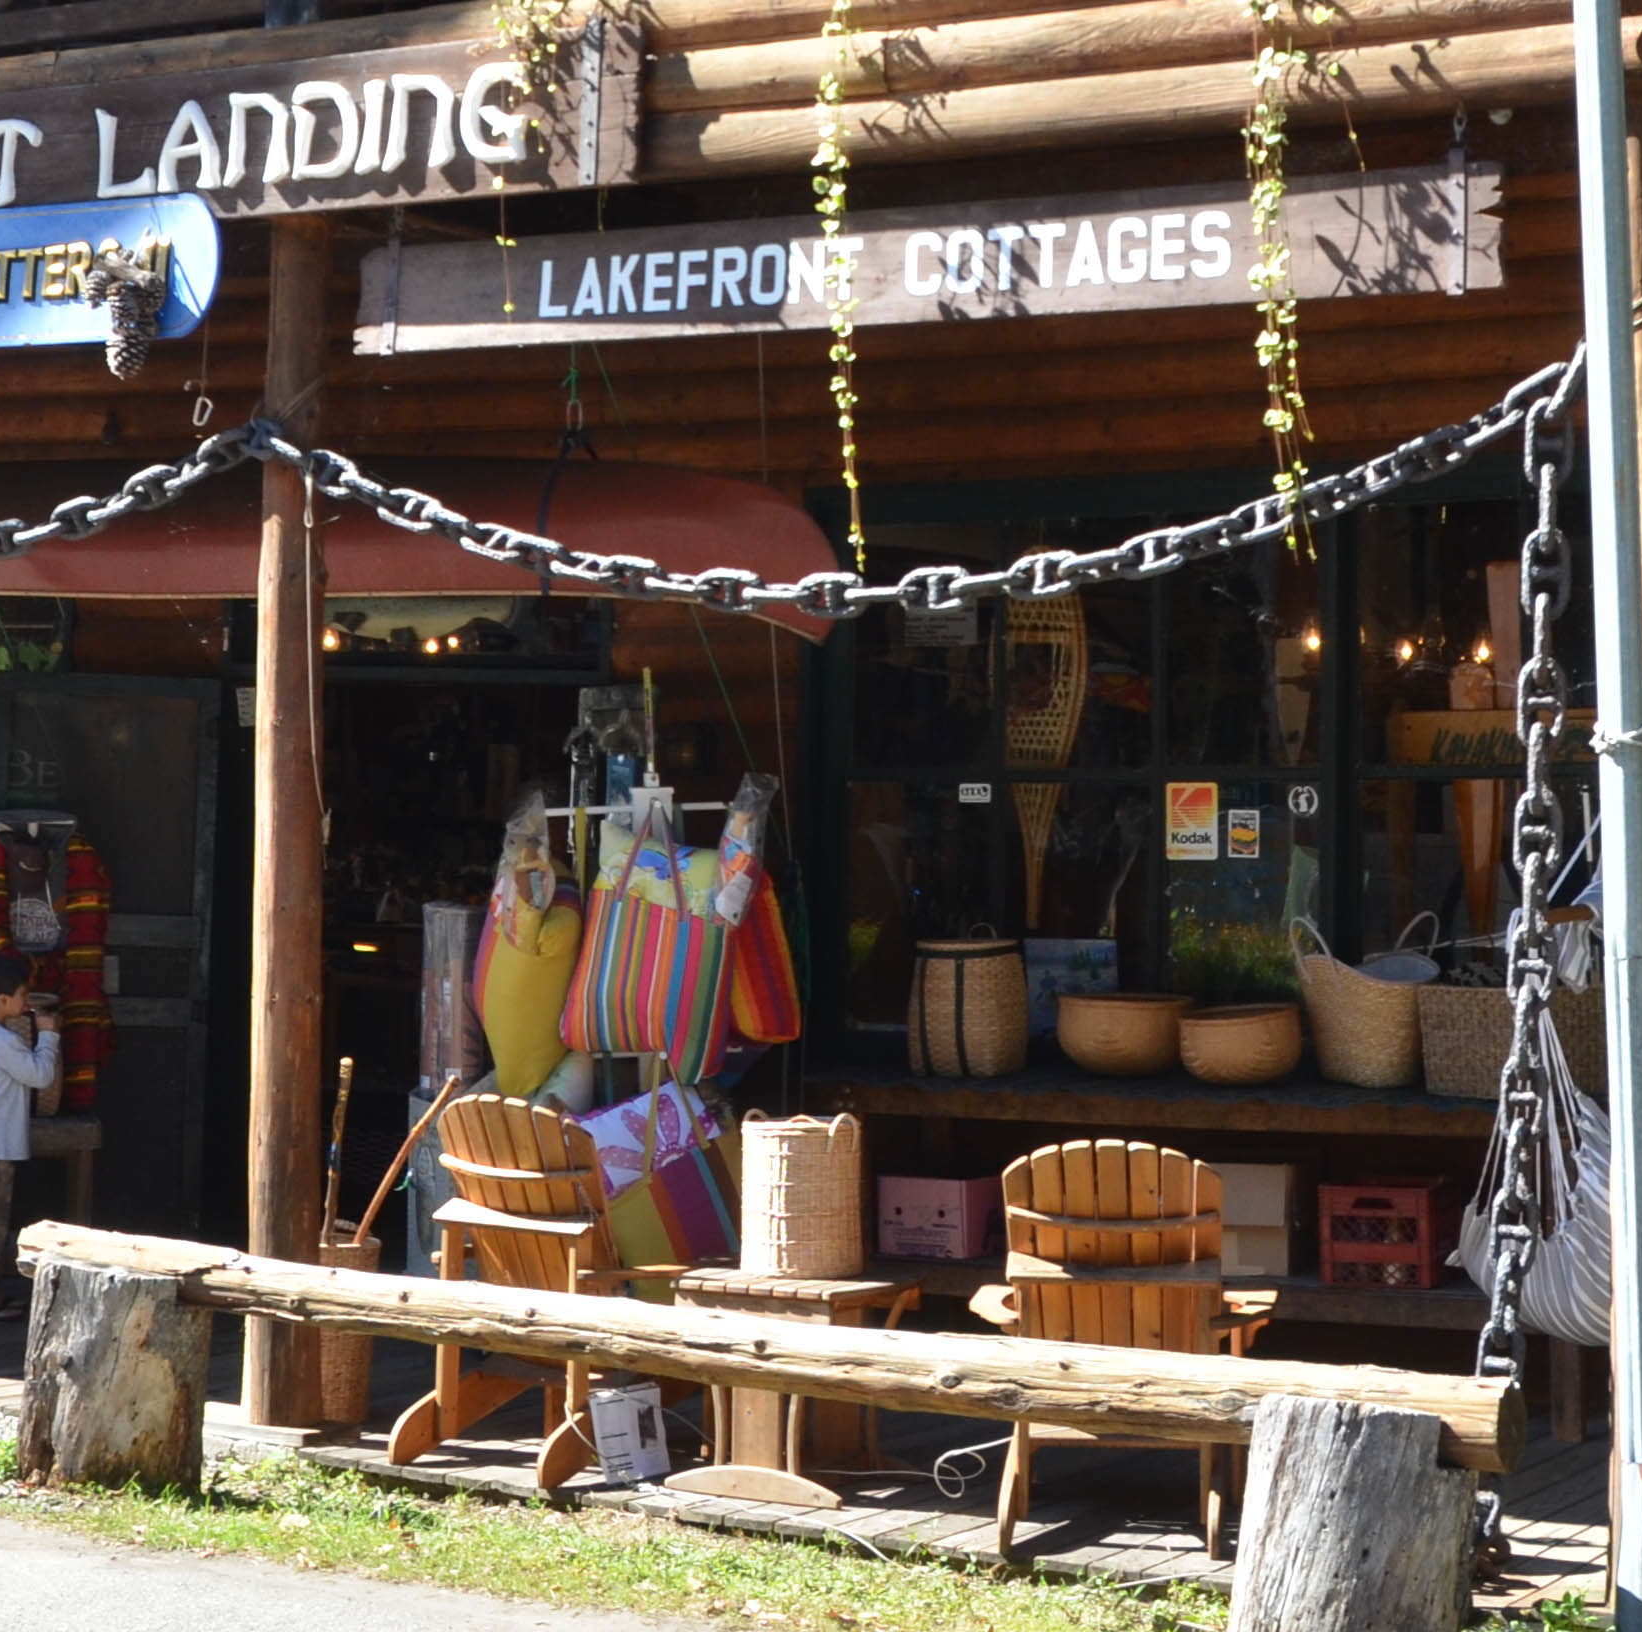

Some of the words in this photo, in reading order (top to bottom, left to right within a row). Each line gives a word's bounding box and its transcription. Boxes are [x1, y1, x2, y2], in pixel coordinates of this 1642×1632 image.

[95, 61, 527, 198] LANDING
[538, 236, 865, 318] LAKEFRONT
[904, 210, 1232, 297] COTTAGES
[1171, 831, 1212, 845] Kodak
